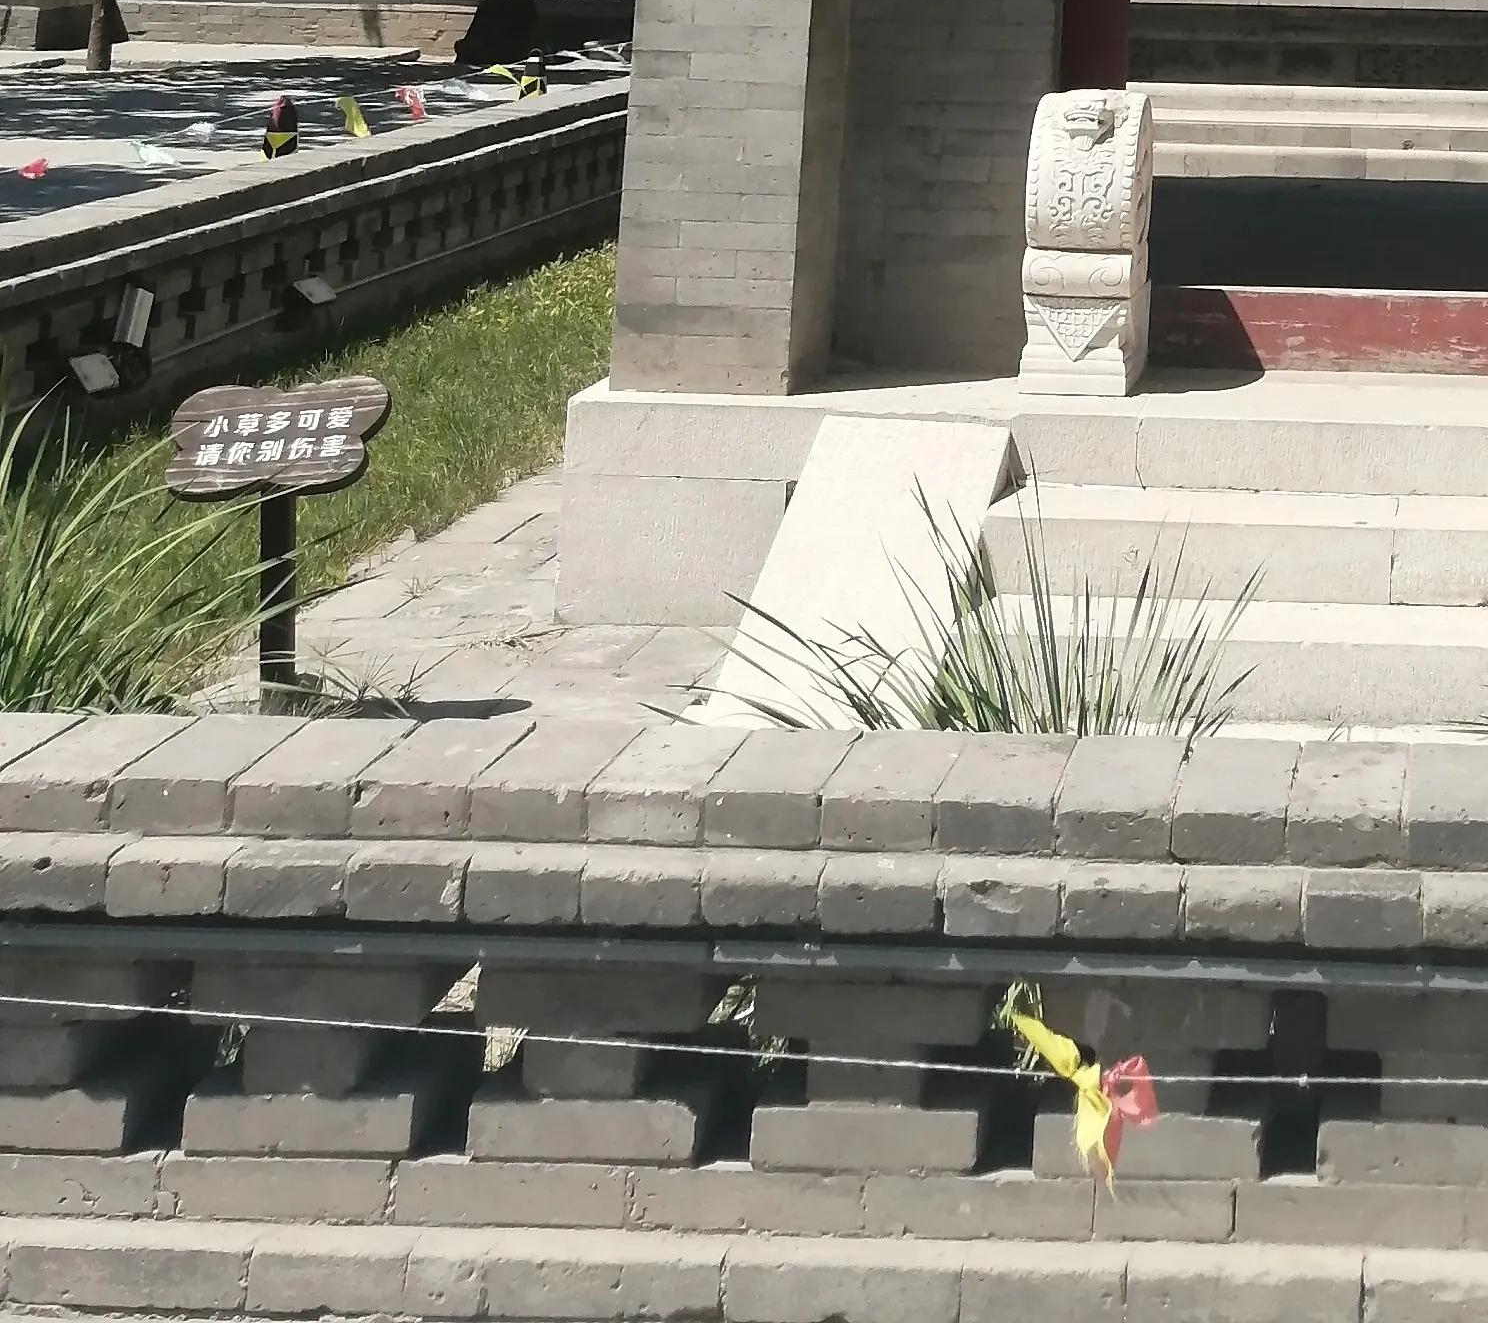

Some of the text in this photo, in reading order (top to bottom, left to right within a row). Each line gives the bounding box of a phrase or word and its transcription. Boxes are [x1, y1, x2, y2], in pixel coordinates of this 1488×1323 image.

[203, 406, 354, 438] 小草多可爱
[196, 434, 347, 466] 请你别伤害
